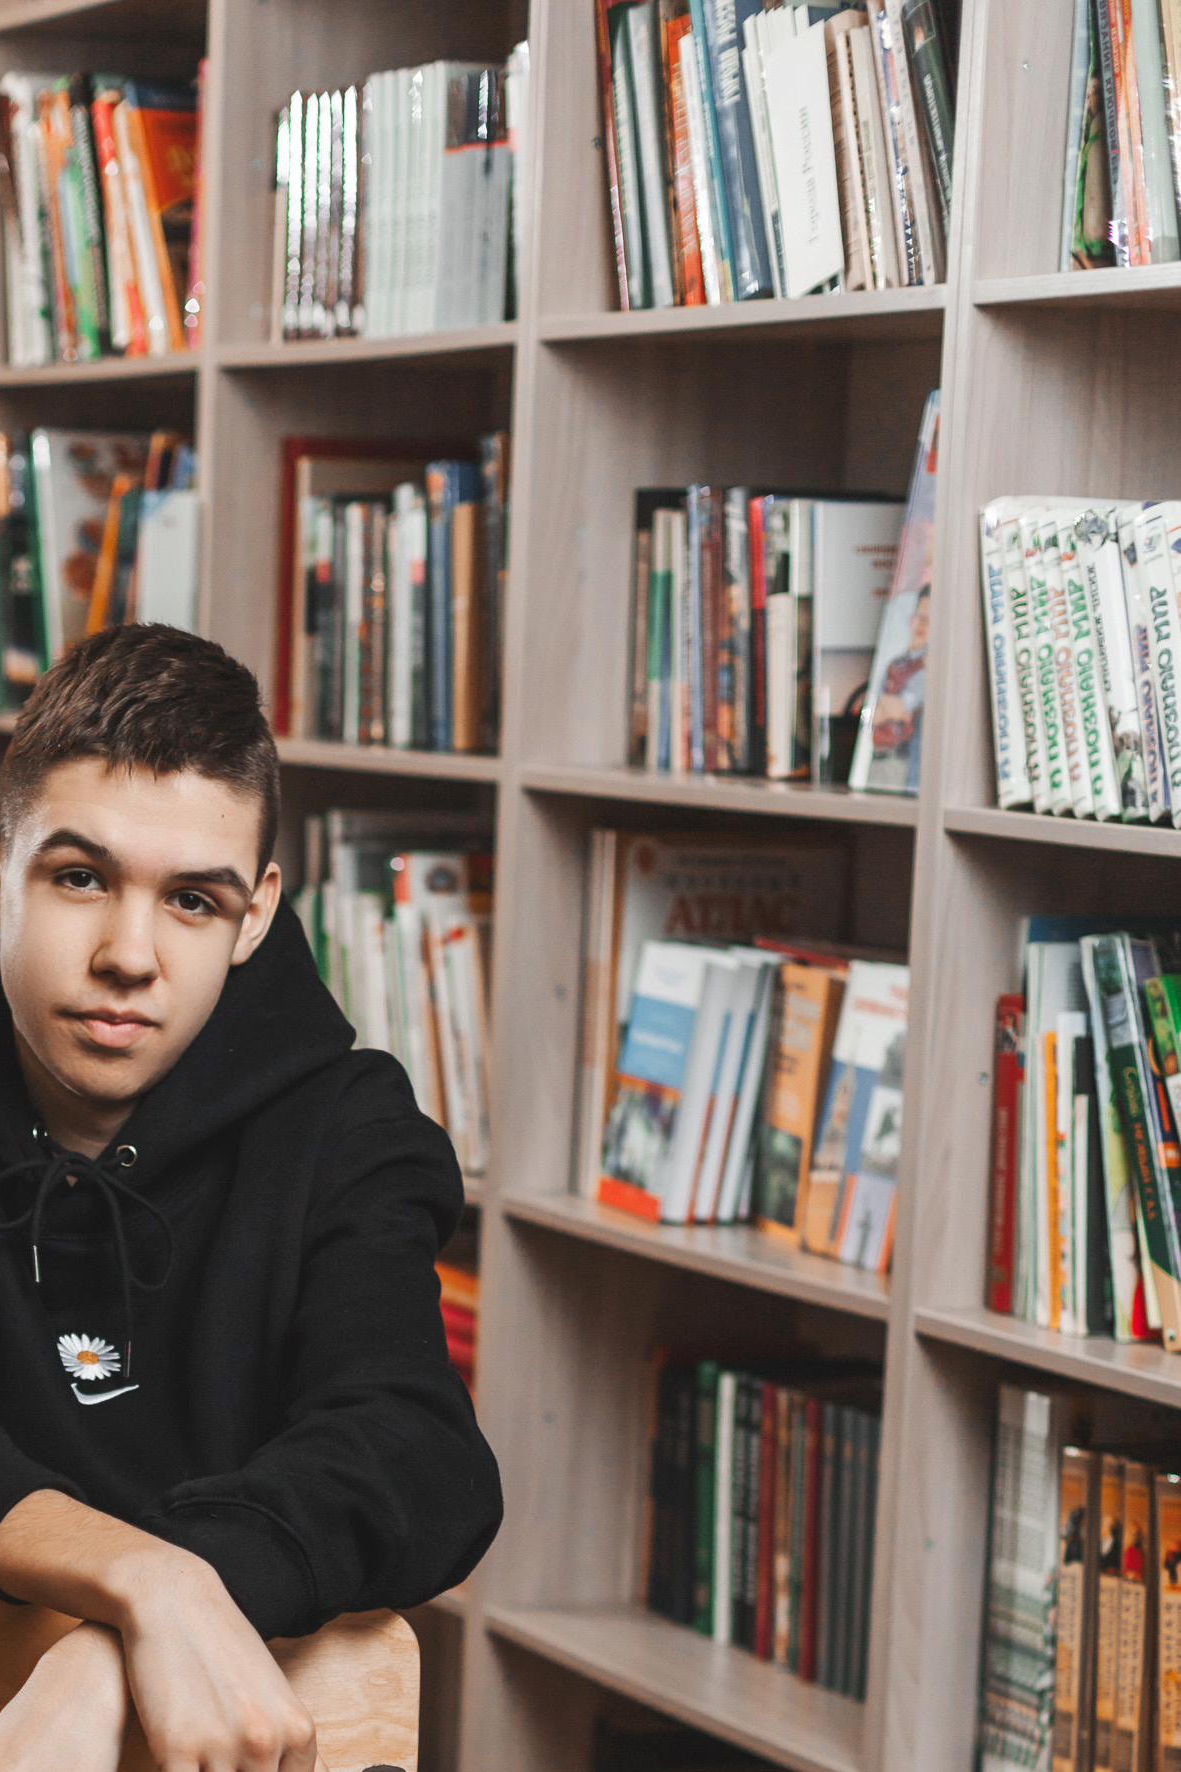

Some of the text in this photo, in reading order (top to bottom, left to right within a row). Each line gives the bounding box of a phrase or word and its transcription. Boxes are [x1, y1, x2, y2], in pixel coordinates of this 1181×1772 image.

[987, 563, 1003, 624] МИР
[1009, 587, 1029, 640] МИР
[1029, 575, 1052, 634] МИР
[1047, 587, 1069, 639] МИР
[1067, 578, 1091, 641] МИР
[1147, 587, 1170, 641] МИР
[1133, 624, 1152, 674] МИР
[991, 633, 1009, 752] ПОЗНАЮ
[1015, 647, 1037, 757] ПОЗНАЮ
[1036, 644, 1060, 762] ПОЗНАЮ
[1054, 647, 1078, 757] ПОЗНАЮ
[1075, 648, 1100, 767] ПОЗНАЮ
[1139, 680, 1158, 785] ПОЗНАЮ
